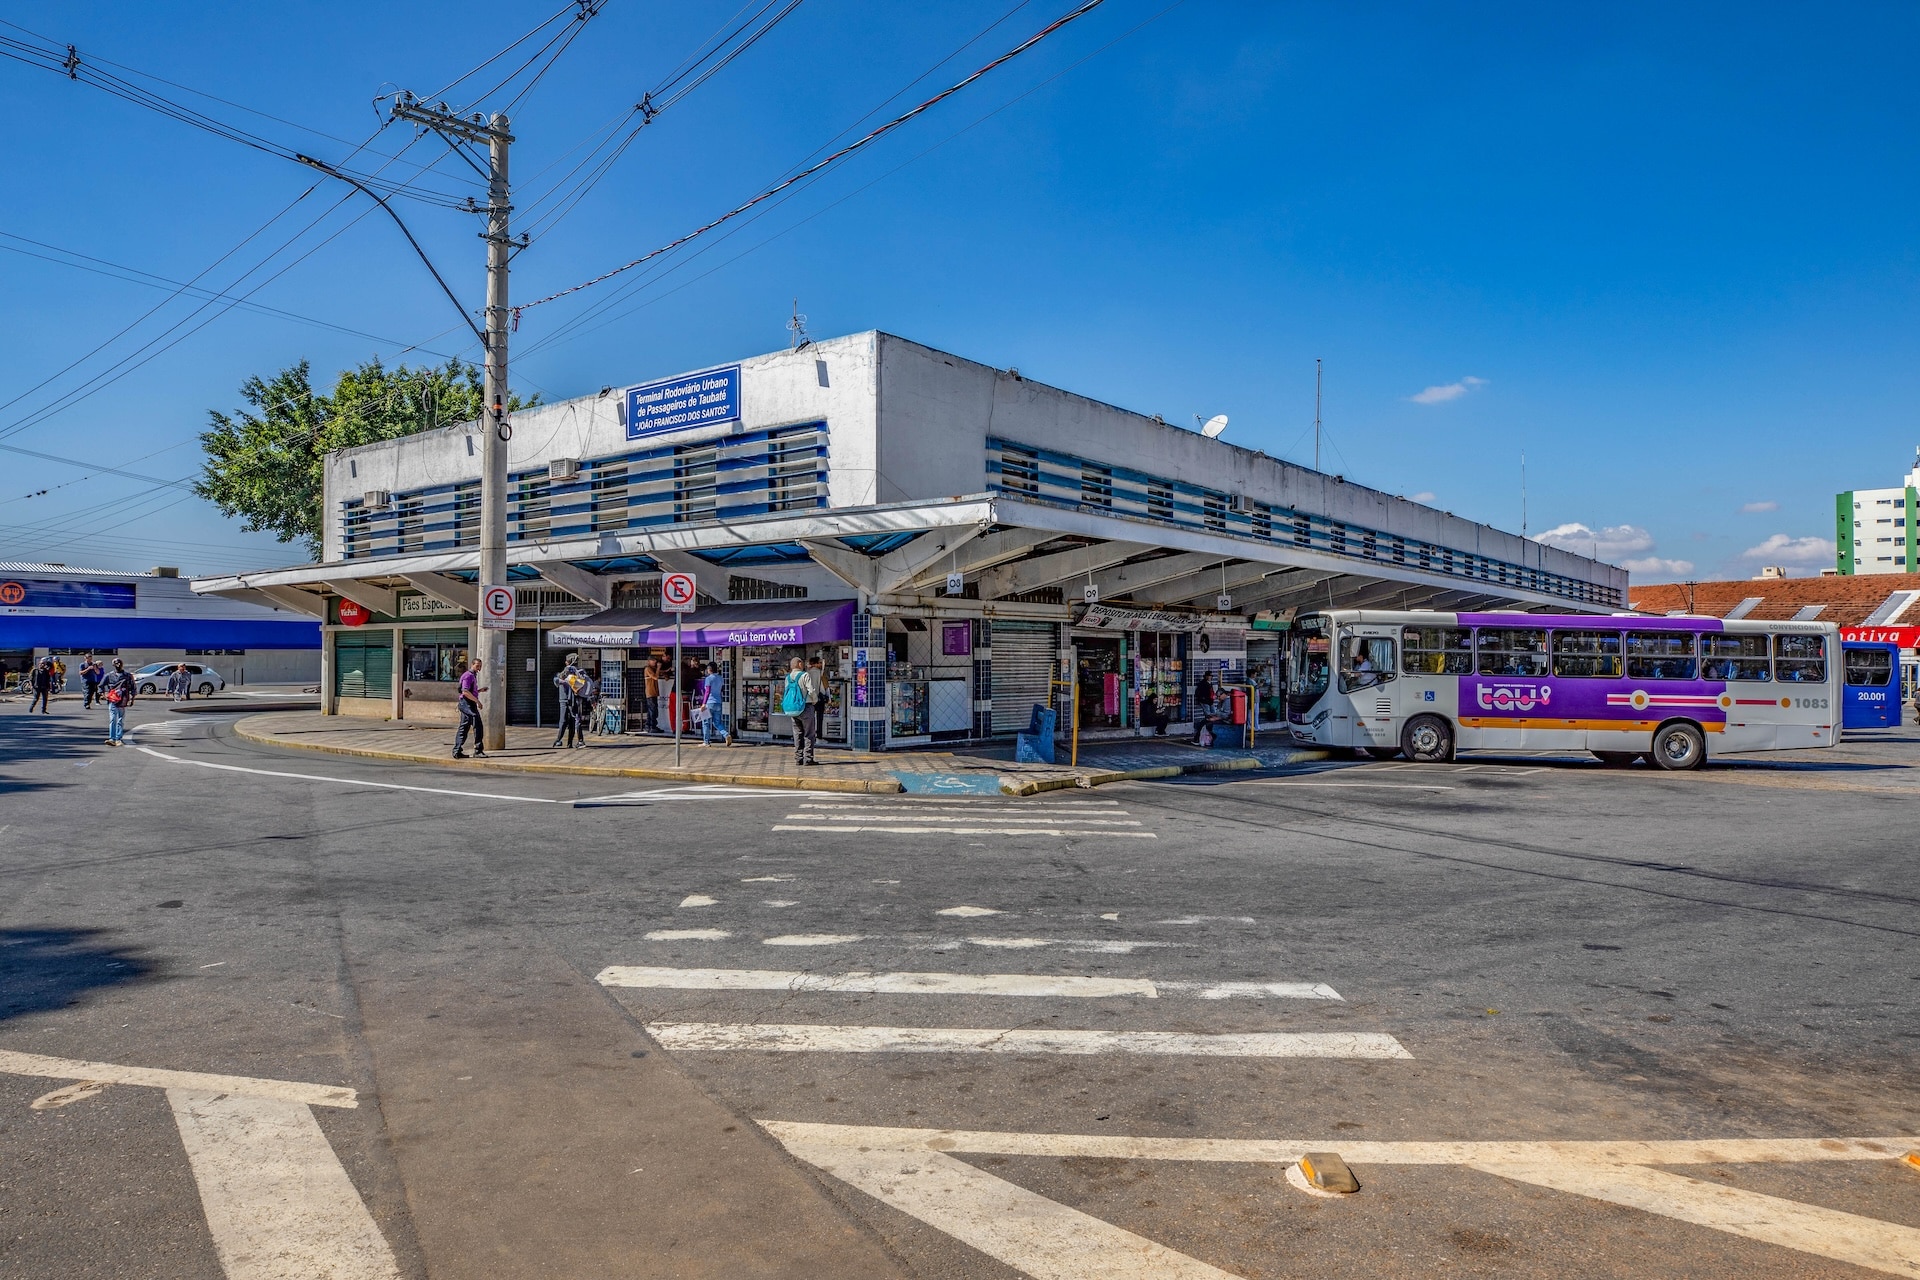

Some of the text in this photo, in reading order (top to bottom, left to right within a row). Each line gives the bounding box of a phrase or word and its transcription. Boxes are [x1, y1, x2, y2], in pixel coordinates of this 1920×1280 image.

[636, 378, 728, 405] Terminal Rodoviário Urbano
[637, 391, 727, 417] de Passageiros de Taubaté
[653, 415, 687, 429] FRANCISCO
[687, 411, 701, 421] DOS
[673, 580, 685, 598] E
[1085, 589, 1097, 598] 09
[402, 597, 420, 611] Pães
[494, 594, 505, 611] E
[1769, 624, 1824, 632] CONVENCIONAL
[552, 634, 596, 645] Lanchonete
[728, 630, 788, 644] Aqui tem vivo
[1476, 683, 1537, 711] tau
[1794, 698, 1828, 709] 1083
[1857, 692, 1885, 701] 20.001
